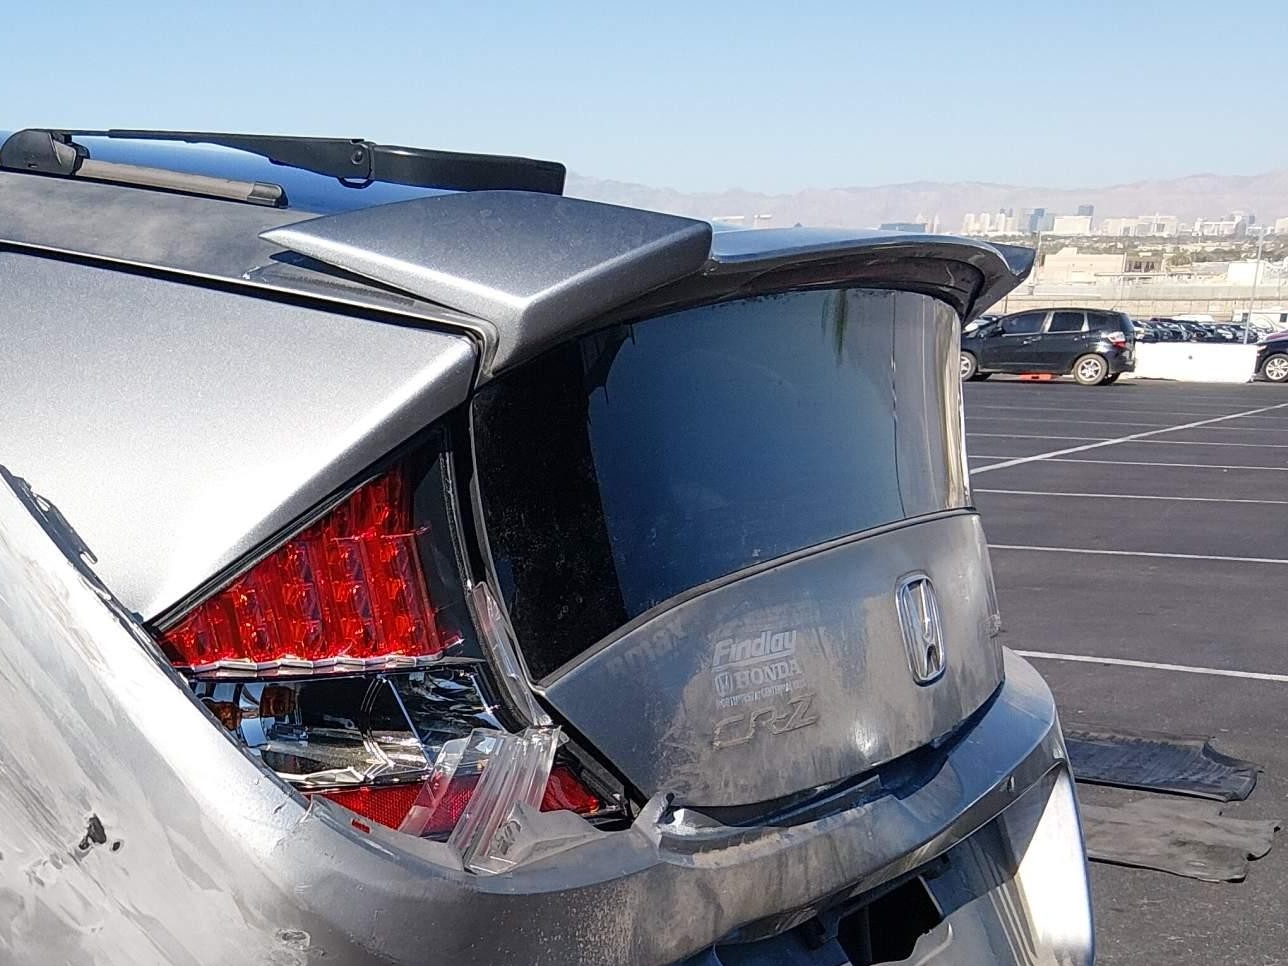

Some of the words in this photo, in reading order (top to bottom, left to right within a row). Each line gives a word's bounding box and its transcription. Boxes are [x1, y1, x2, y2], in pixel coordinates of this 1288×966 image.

[713, 630, 797, 666] Findlay
[735, 658, 802, 690] HONDA
[713, 692, 817, 750] CR-Z
